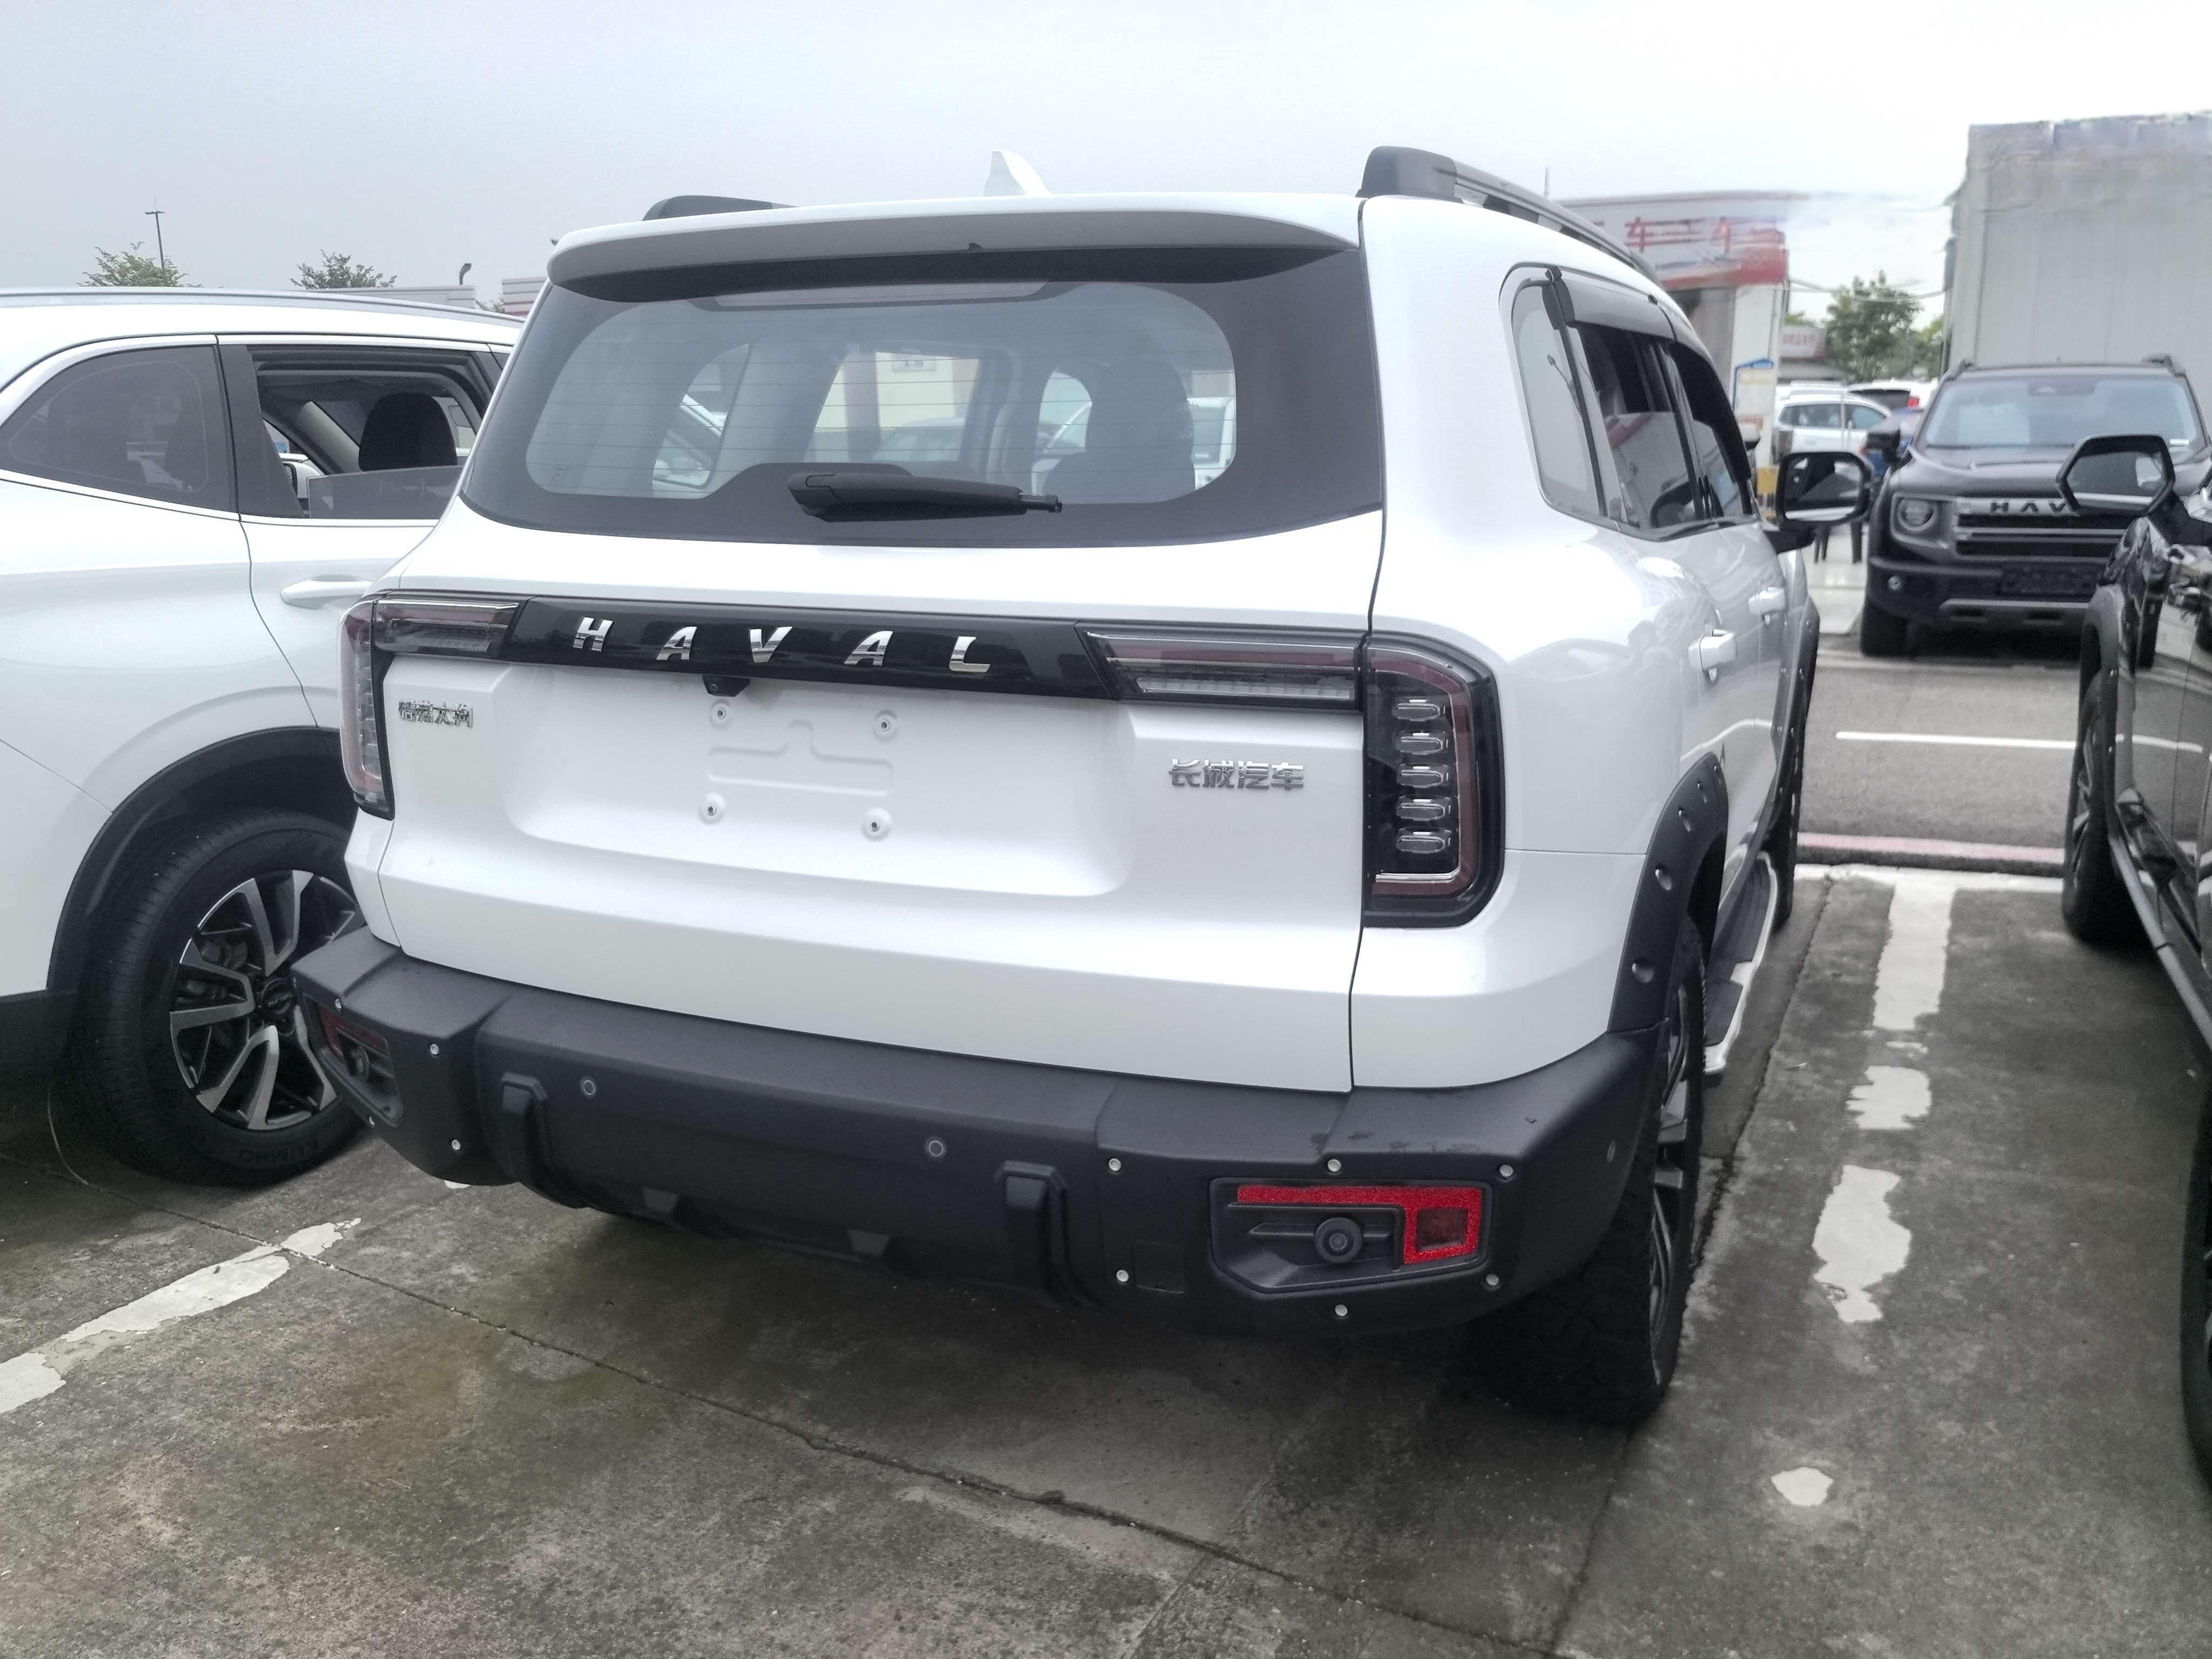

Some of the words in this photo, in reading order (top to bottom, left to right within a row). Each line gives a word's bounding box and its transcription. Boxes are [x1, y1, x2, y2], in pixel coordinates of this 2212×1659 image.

[1990, 501, 2066, 512] HAV
[572, 616, 991, 673] HAVAL
[1169, 758, 1304, 790] 长城汽车
